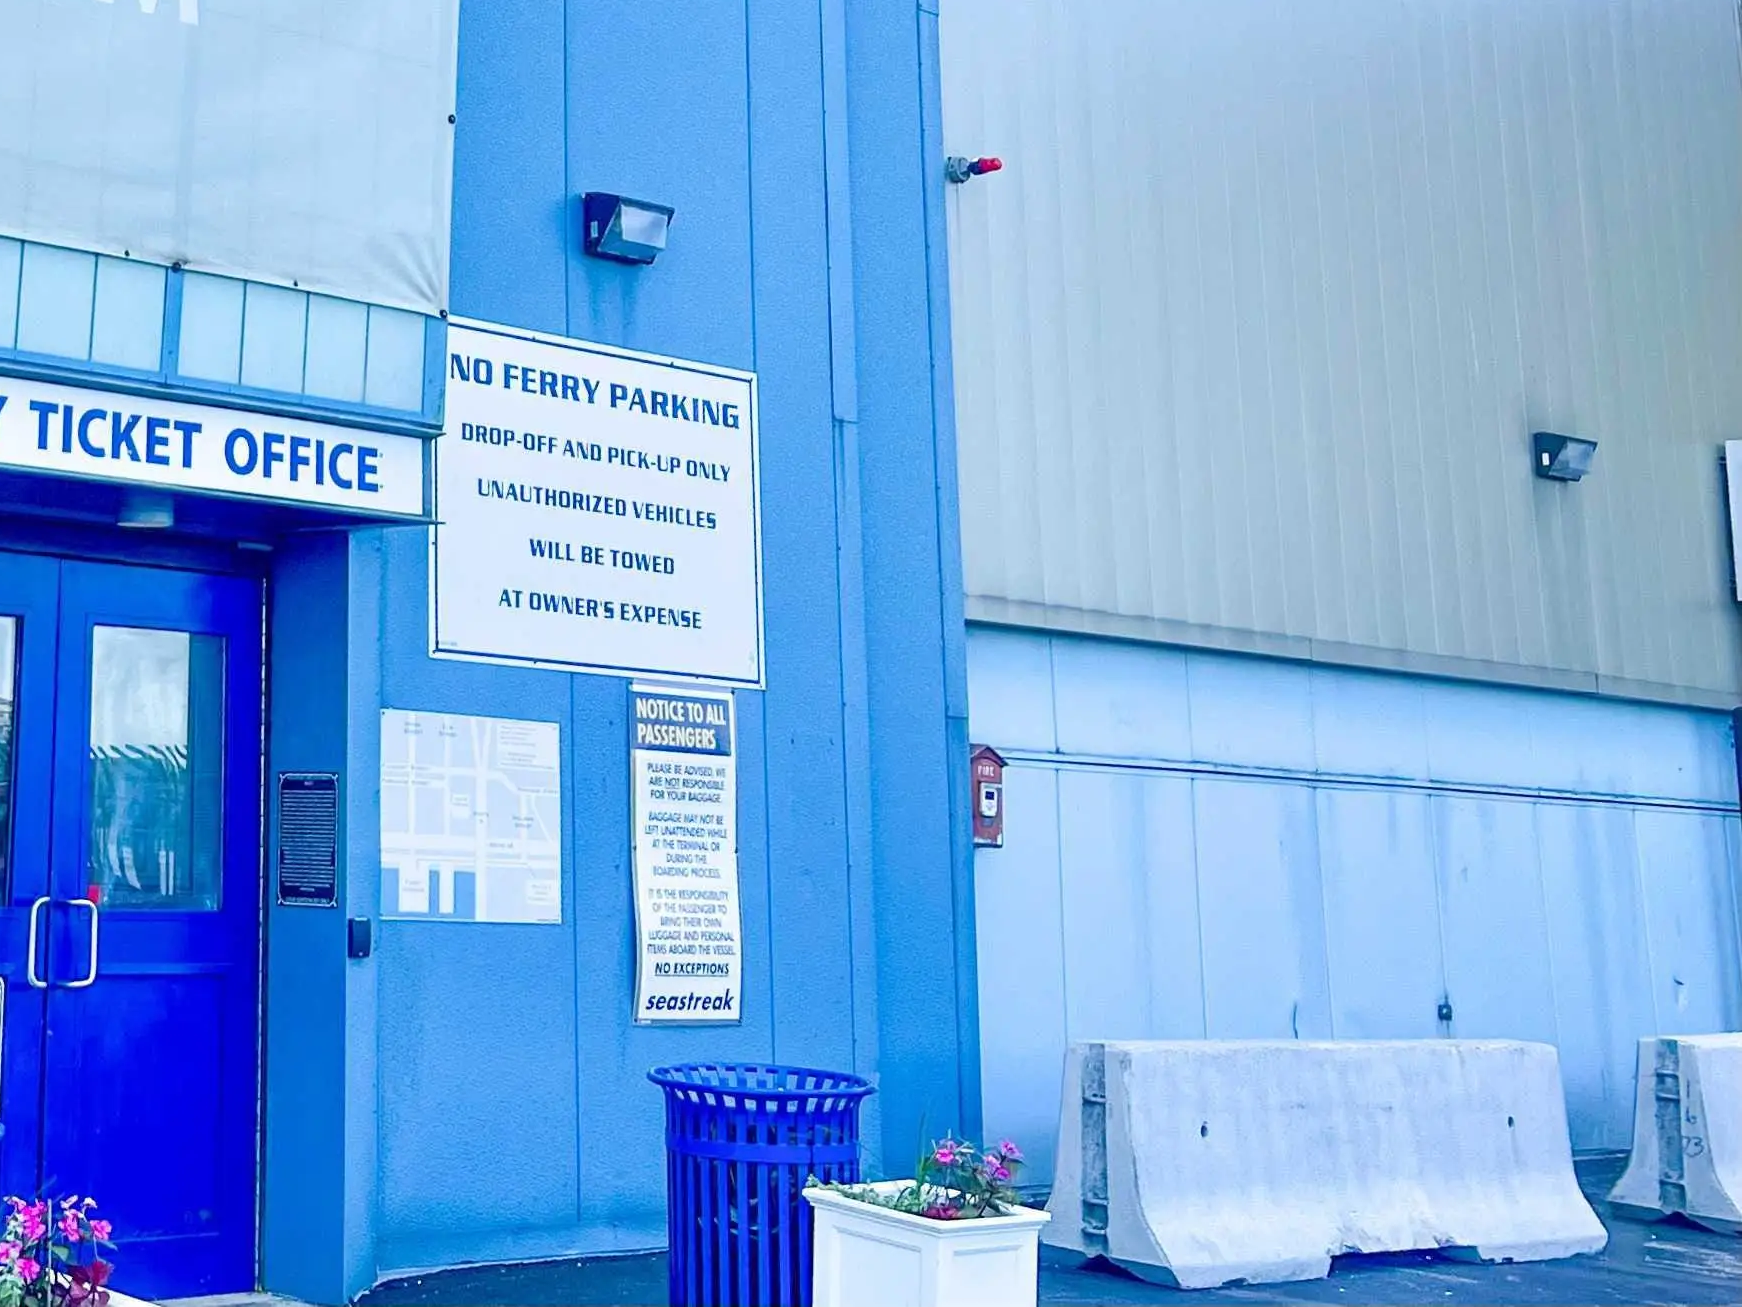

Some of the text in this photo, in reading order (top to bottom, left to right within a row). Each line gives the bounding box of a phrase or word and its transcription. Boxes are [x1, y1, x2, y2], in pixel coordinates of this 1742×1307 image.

[450, 352, 740, 429] NO FERRY PARKING
[29, 398, 204, 469] TICKET
[224, 428, 382, 493] OFFICE
[461, 422, 730, 483] DROP-OFF AND PICK-UP ONLY
[477, 478, 717, 530] UNAUTHORIZED VEHICLES
[530, 538, 675, 575] WILL BE TOWED
[498, 588, 702, 629] AT OWNER'S EXPENSE
[636, 697, 726, 725] NOTICE TO ALL
[637, 723, 716, 749] PASSENGERS
[655, 962, 729, 975] NO EXCEPTIONS
[646, 988, 734, 1011] seastreak
